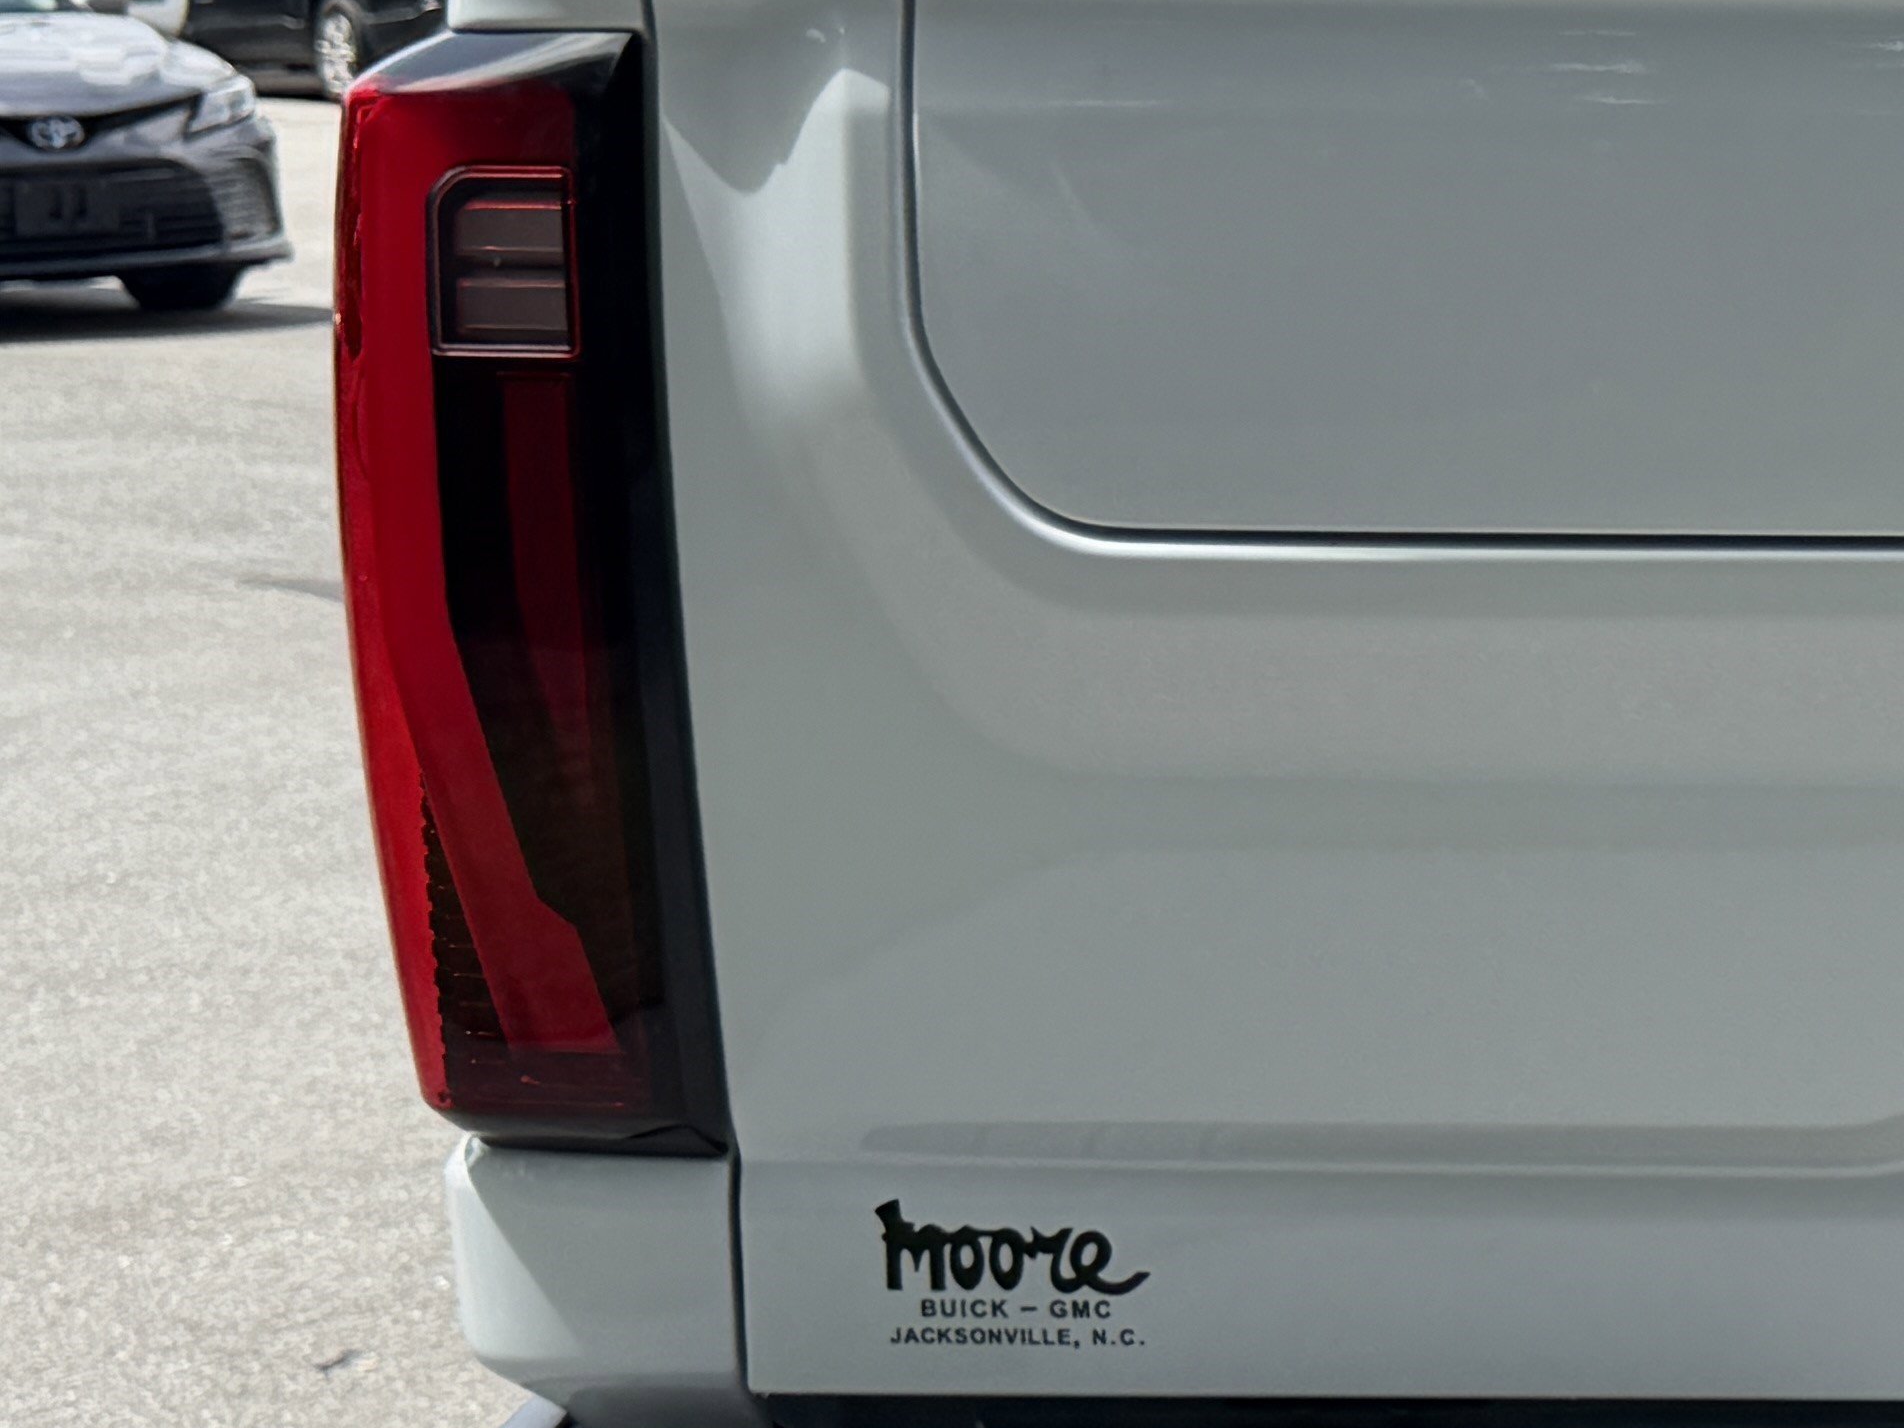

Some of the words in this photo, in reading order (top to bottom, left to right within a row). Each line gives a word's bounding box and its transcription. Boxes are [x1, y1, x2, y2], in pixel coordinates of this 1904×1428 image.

[920, 1298, 1009, 1319] BUICK
[1049, 1299, 1112, 1319] GMC
[890, 1327, 1080, 1349] JACKSONVILLE,
[1092, 1329, 1146, 1346] N.C.
